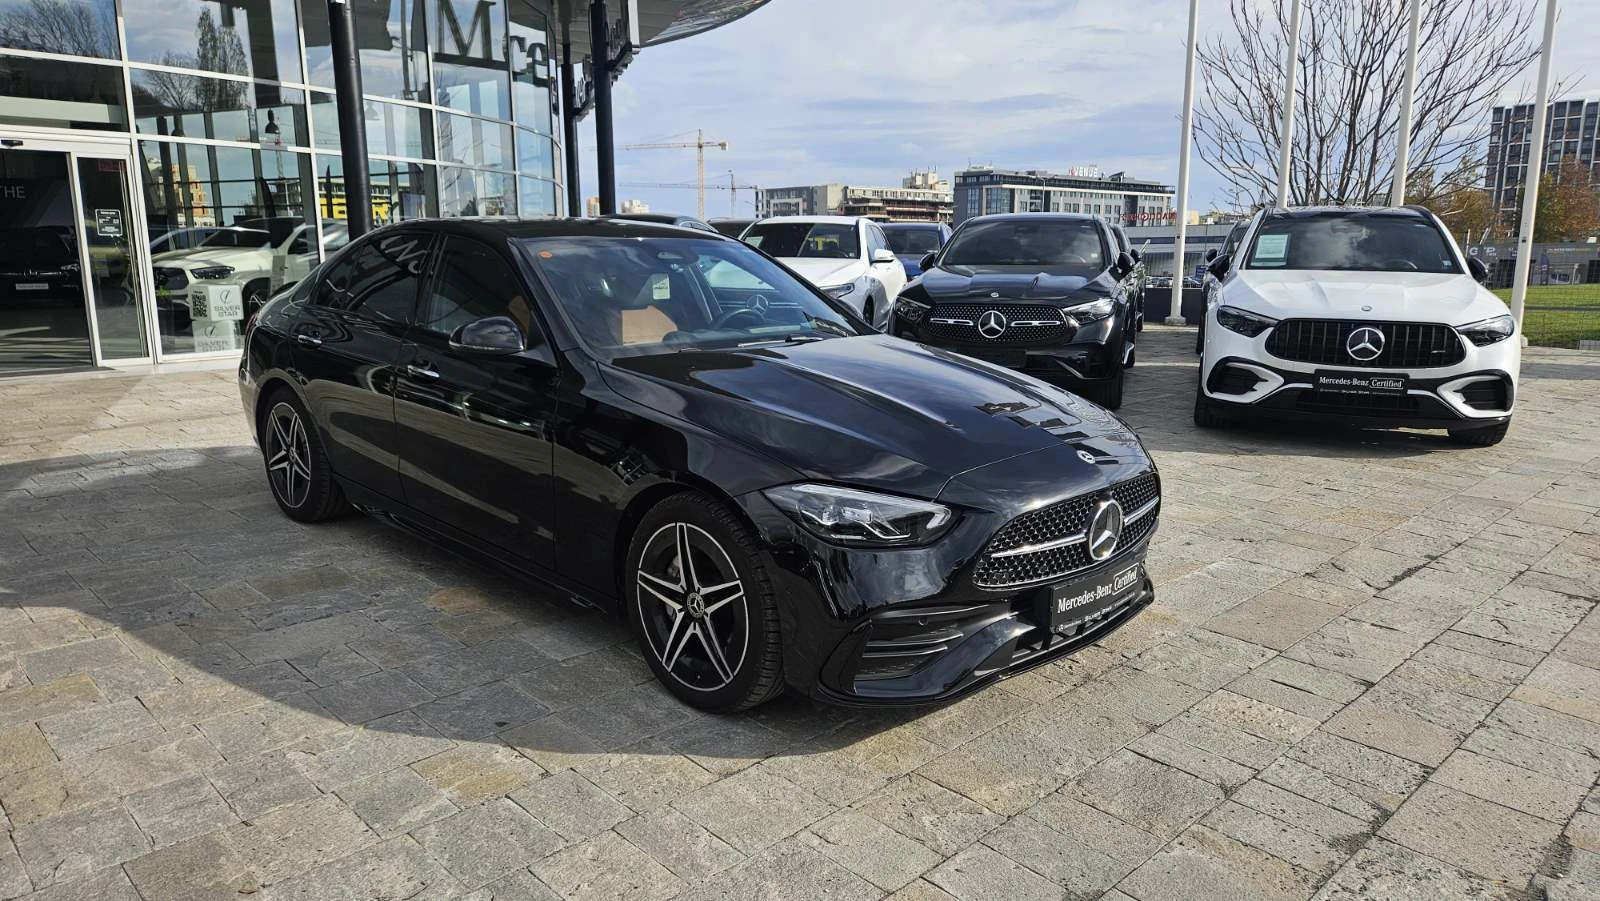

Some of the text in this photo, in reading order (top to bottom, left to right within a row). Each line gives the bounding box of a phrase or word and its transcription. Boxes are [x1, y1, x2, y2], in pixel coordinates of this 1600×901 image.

[214, 304, 241, 312] SILVER
[1319, 376, 1402, 388] Mercedes-Benz Certified
[1057, 583, 1113, 614] Mercedes-Benz
[1114, 566, 1138, 591] Certified
